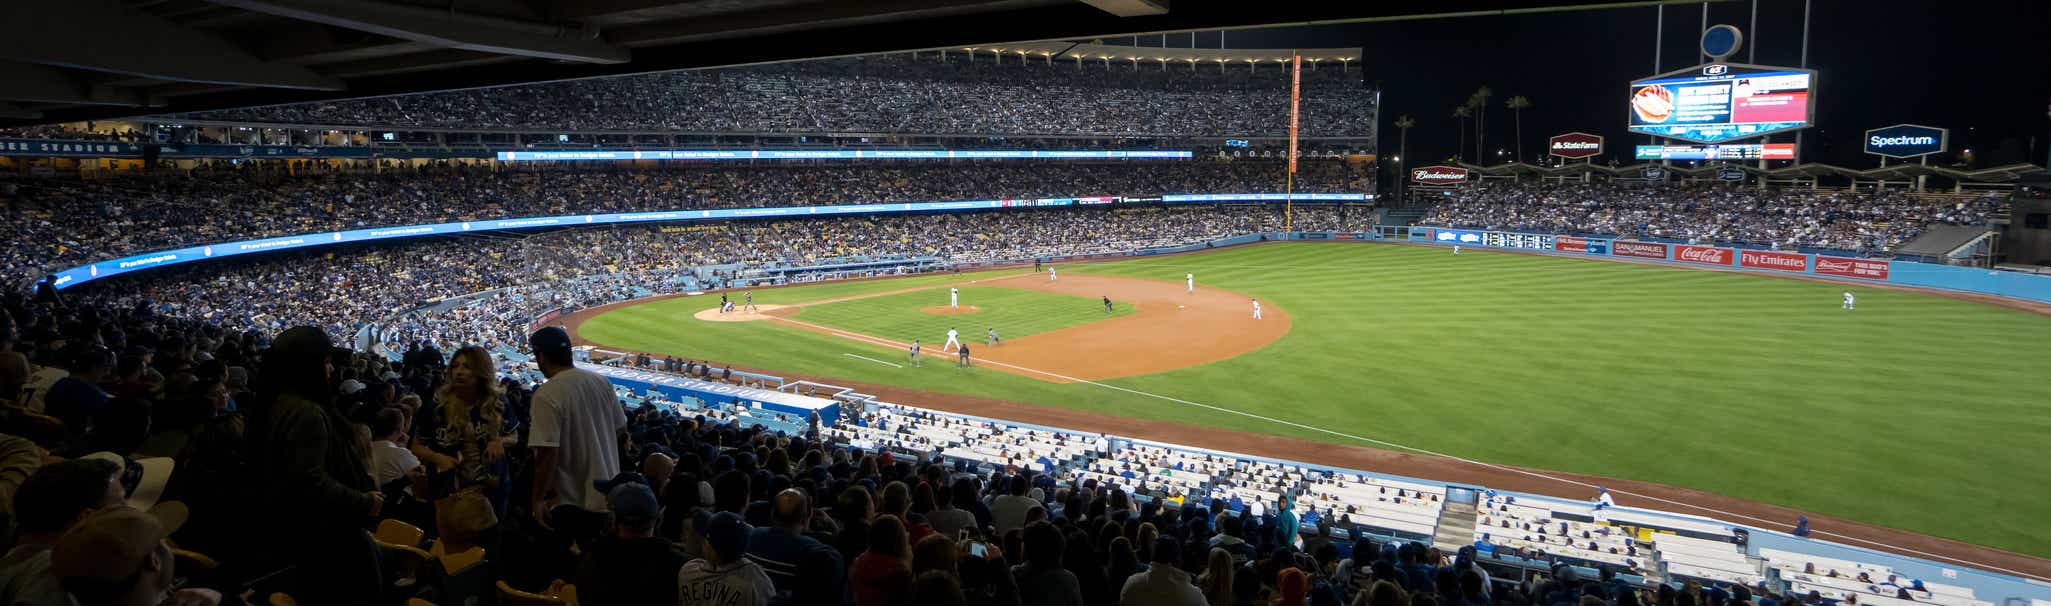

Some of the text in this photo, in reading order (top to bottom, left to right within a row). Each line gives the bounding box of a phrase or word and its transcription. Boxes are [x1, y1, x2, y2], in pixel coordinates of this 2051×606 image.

[41, 143, 119, 152] STADIUM
[1870, 135, 1932, 148] Spectrum
[1414, 169, 1465, 181] Budweiser
[1742, 253, 1805, 268] Fly Emirates
